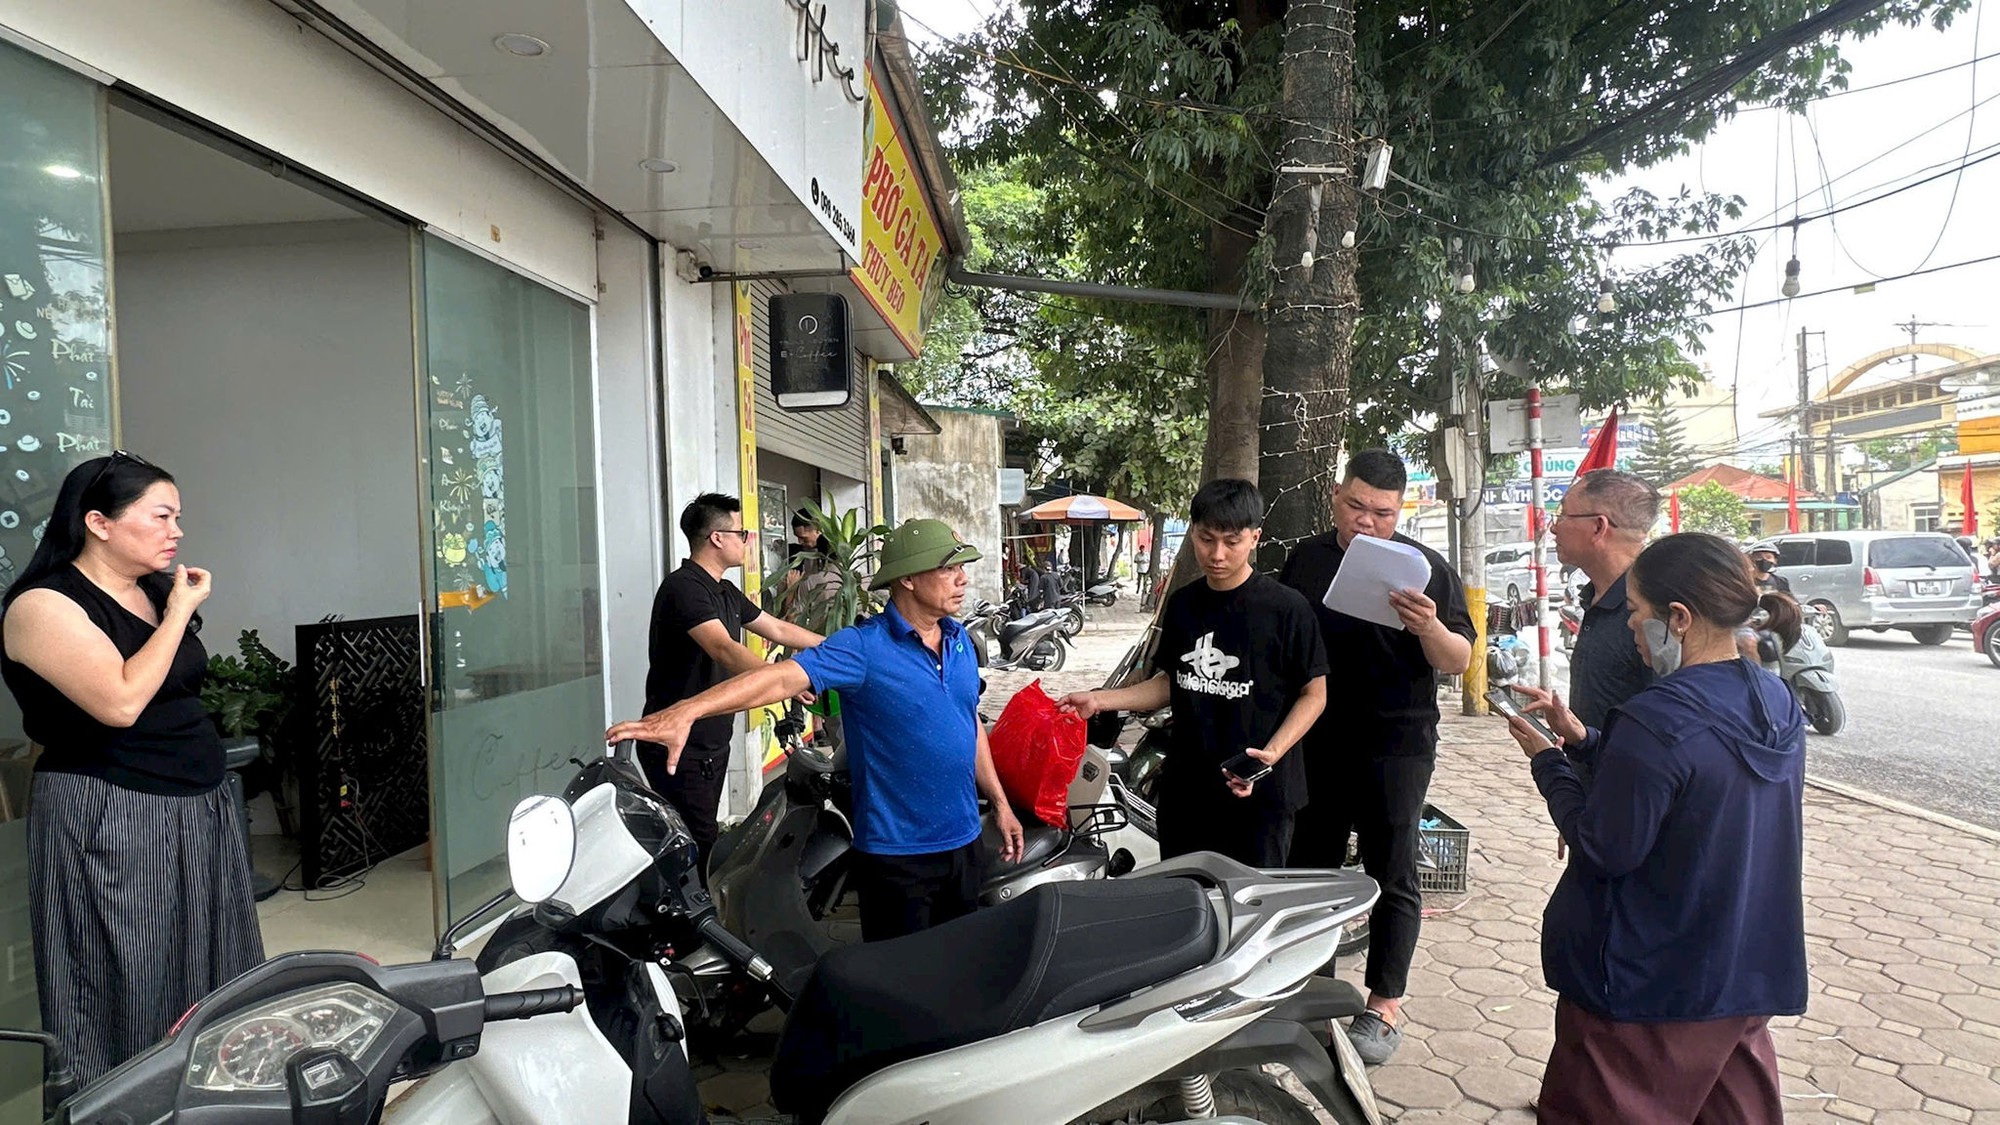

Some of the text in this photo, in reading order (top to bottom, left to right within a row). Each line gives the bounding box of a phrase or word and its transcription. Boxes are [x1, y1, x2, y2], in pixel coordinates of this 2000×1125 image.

[863, 144, 930, 292] PHỞ GÀ TA
[886, 277, 905, 315] BÉO
[69, 386, 94, 409] Tài
[1523, 456, 1576, 473] CỦNG
[1513, 484, 1563, 502] THỐC
